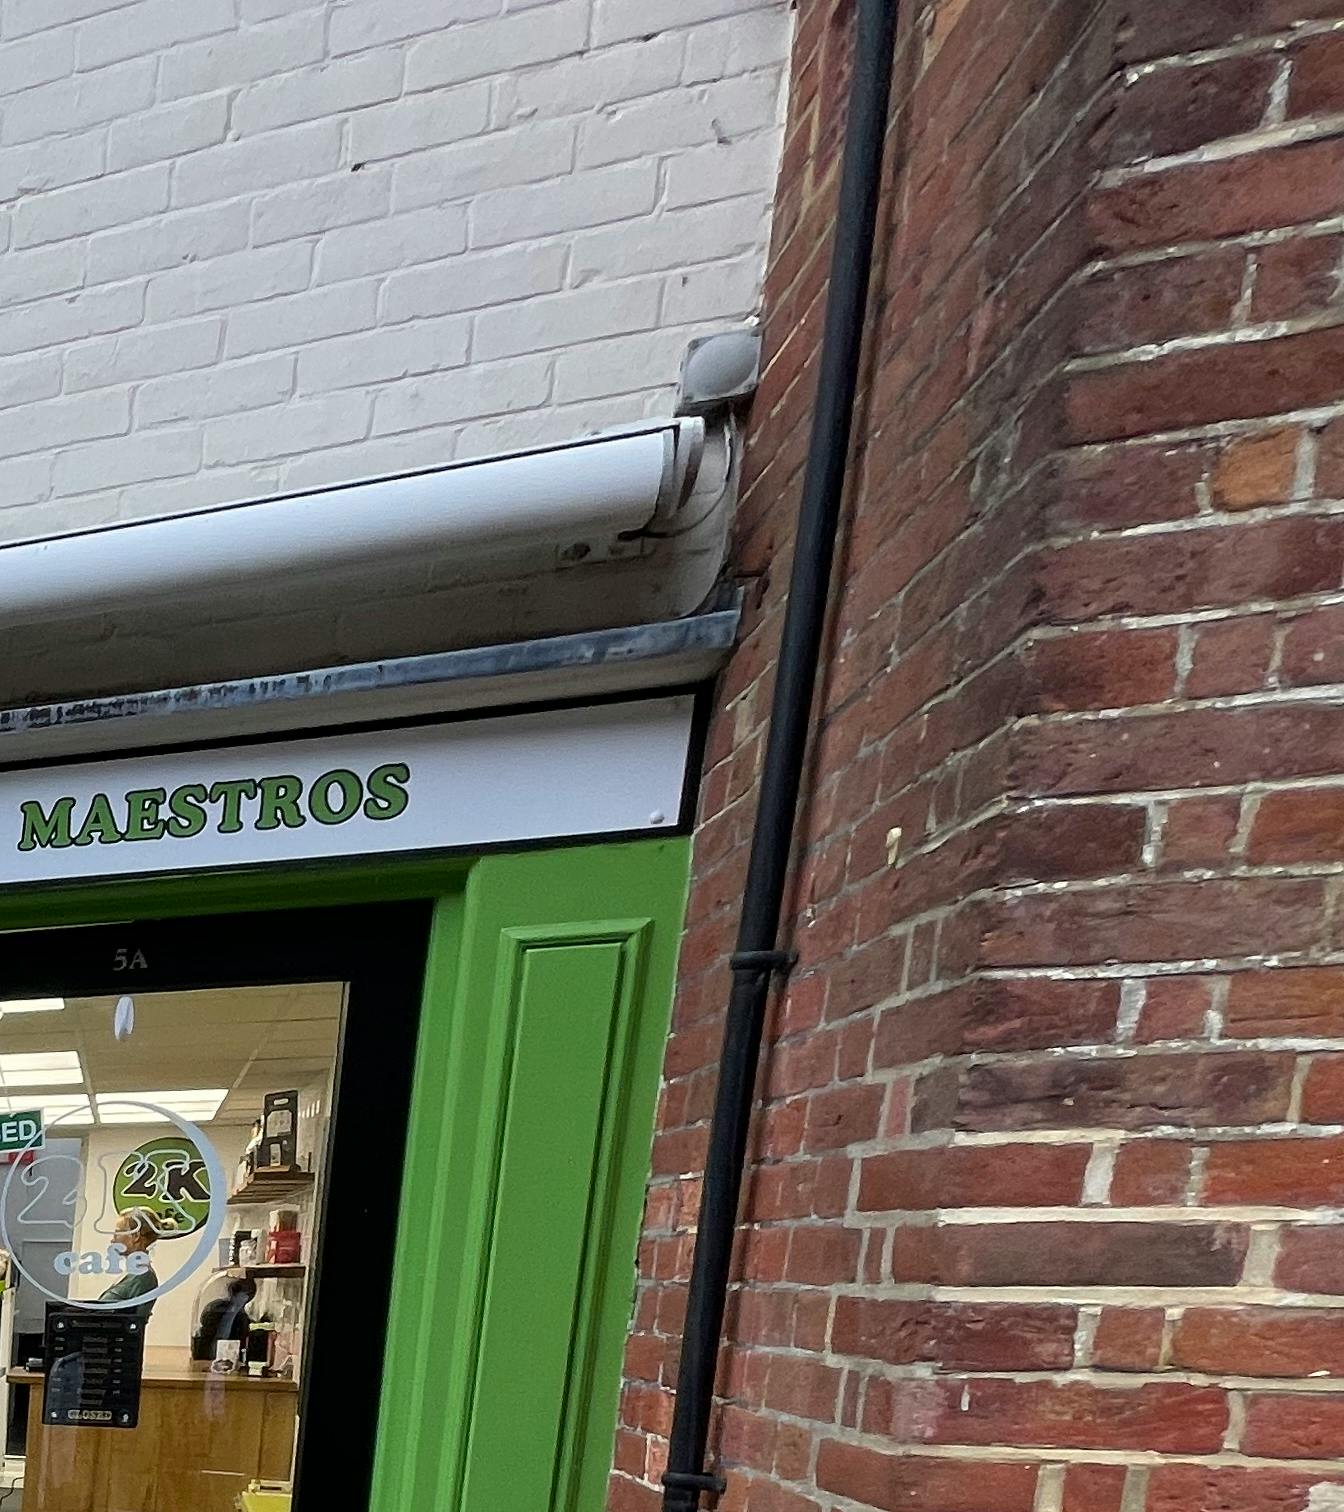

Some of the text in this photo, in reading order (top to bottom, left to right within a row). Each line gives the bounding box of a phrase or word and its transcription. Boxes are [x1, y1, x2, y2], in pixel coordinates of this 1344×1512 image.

[18, 763, 411, 852] MAESTROS
[113, 948, 148, 971] 5A
[121, 1159, 212, 1203] 2K
